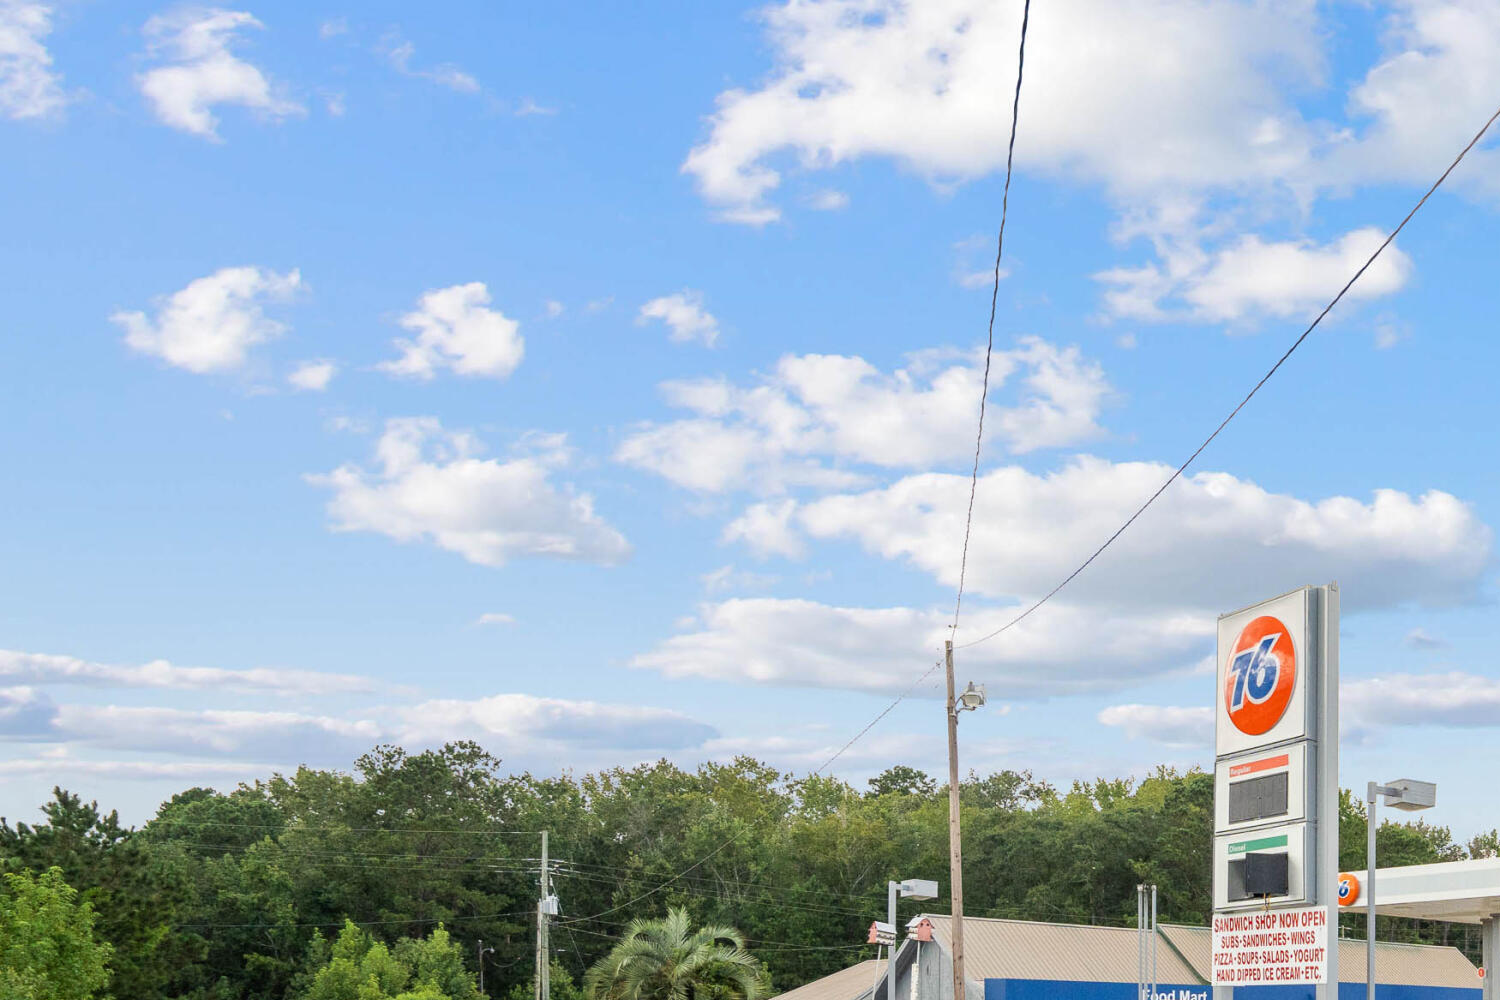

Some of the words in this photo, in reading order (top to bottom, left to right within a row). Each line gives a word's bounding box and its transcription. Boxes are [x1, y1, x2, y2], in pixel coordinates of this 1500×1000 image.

[1230, 633, 1282, 714] 76
[1338, 880, 1350, 898] 6
[1214, 916, 1253, 933] SANDWICH
[1256, 914, 1277, 930] SHOP
[1279, 912, 1299, 928] NOW
[1301, 910, 1326, 927] OPEN
[1216, 969, 1235, 982] HAND
[1237, 967, 1260, 981] DIPPED
[1262, 967, 1274, 981] ICE
[1275, 966, 1300, 980] CREAM
